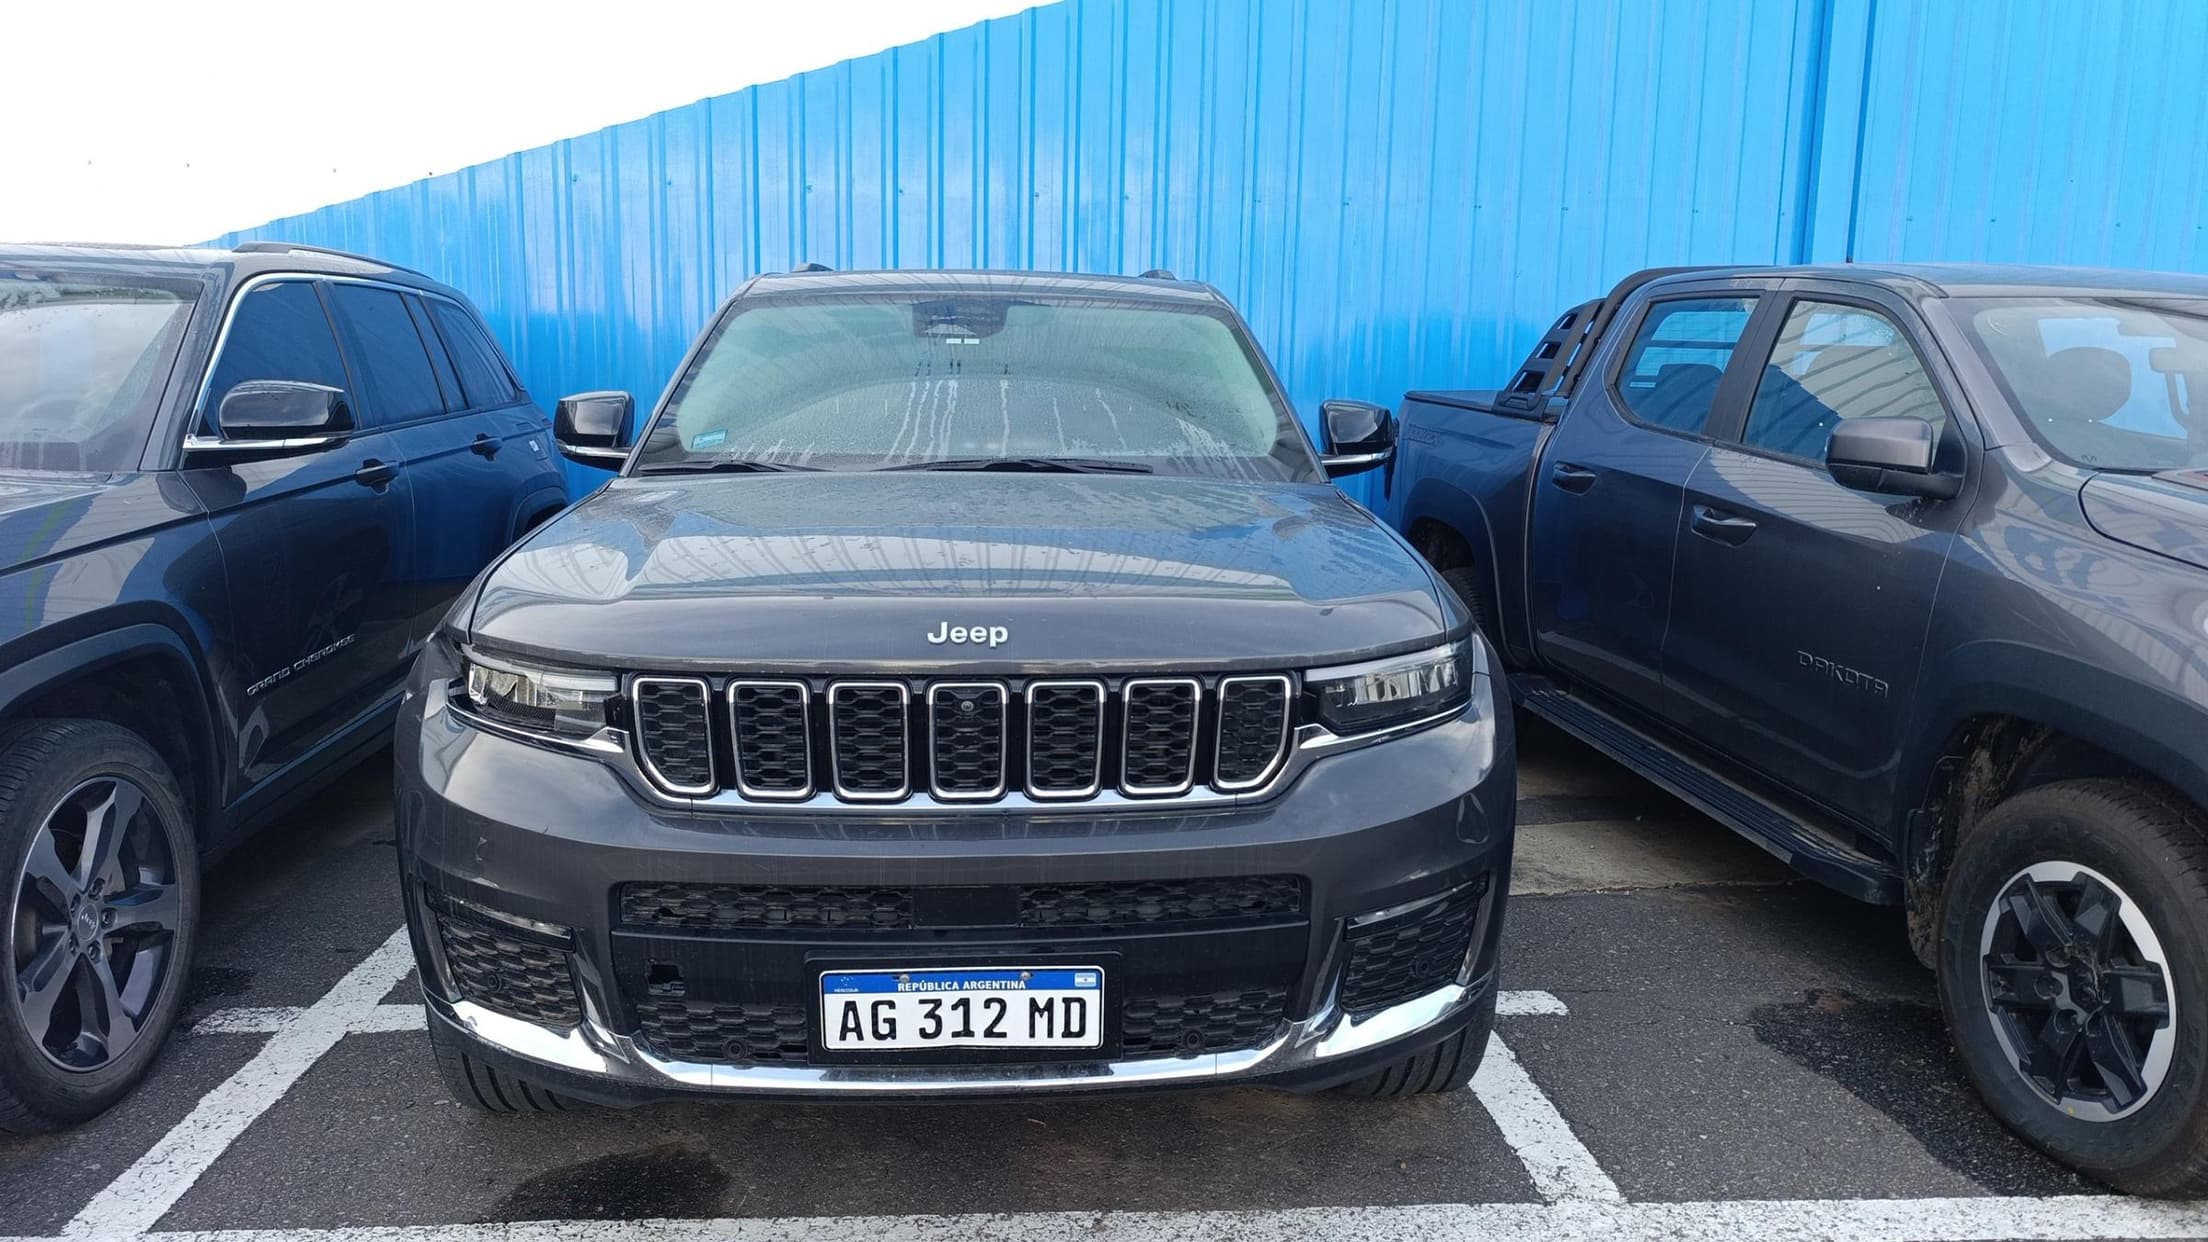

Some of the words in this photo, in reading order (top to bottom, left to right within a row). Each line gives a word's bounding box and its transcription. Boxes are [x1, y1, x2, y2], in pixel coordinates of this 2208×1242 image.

[927, 621, 1009, 649] Jeep
[246, 666, 291, 697] GRAND
[293, 633, 357, 671] CHEROKEE
[1797, 650, 1889, 700] DAKOTA
[898, 979, 960, 992] REPÚBLICA
[963, 980, 1027, 991] ARGENTINA
[839, 1000, 898, 1042] AG
[918, 997, 1008, 1041] 312
[1029, 997, 1088, 1040] MD
